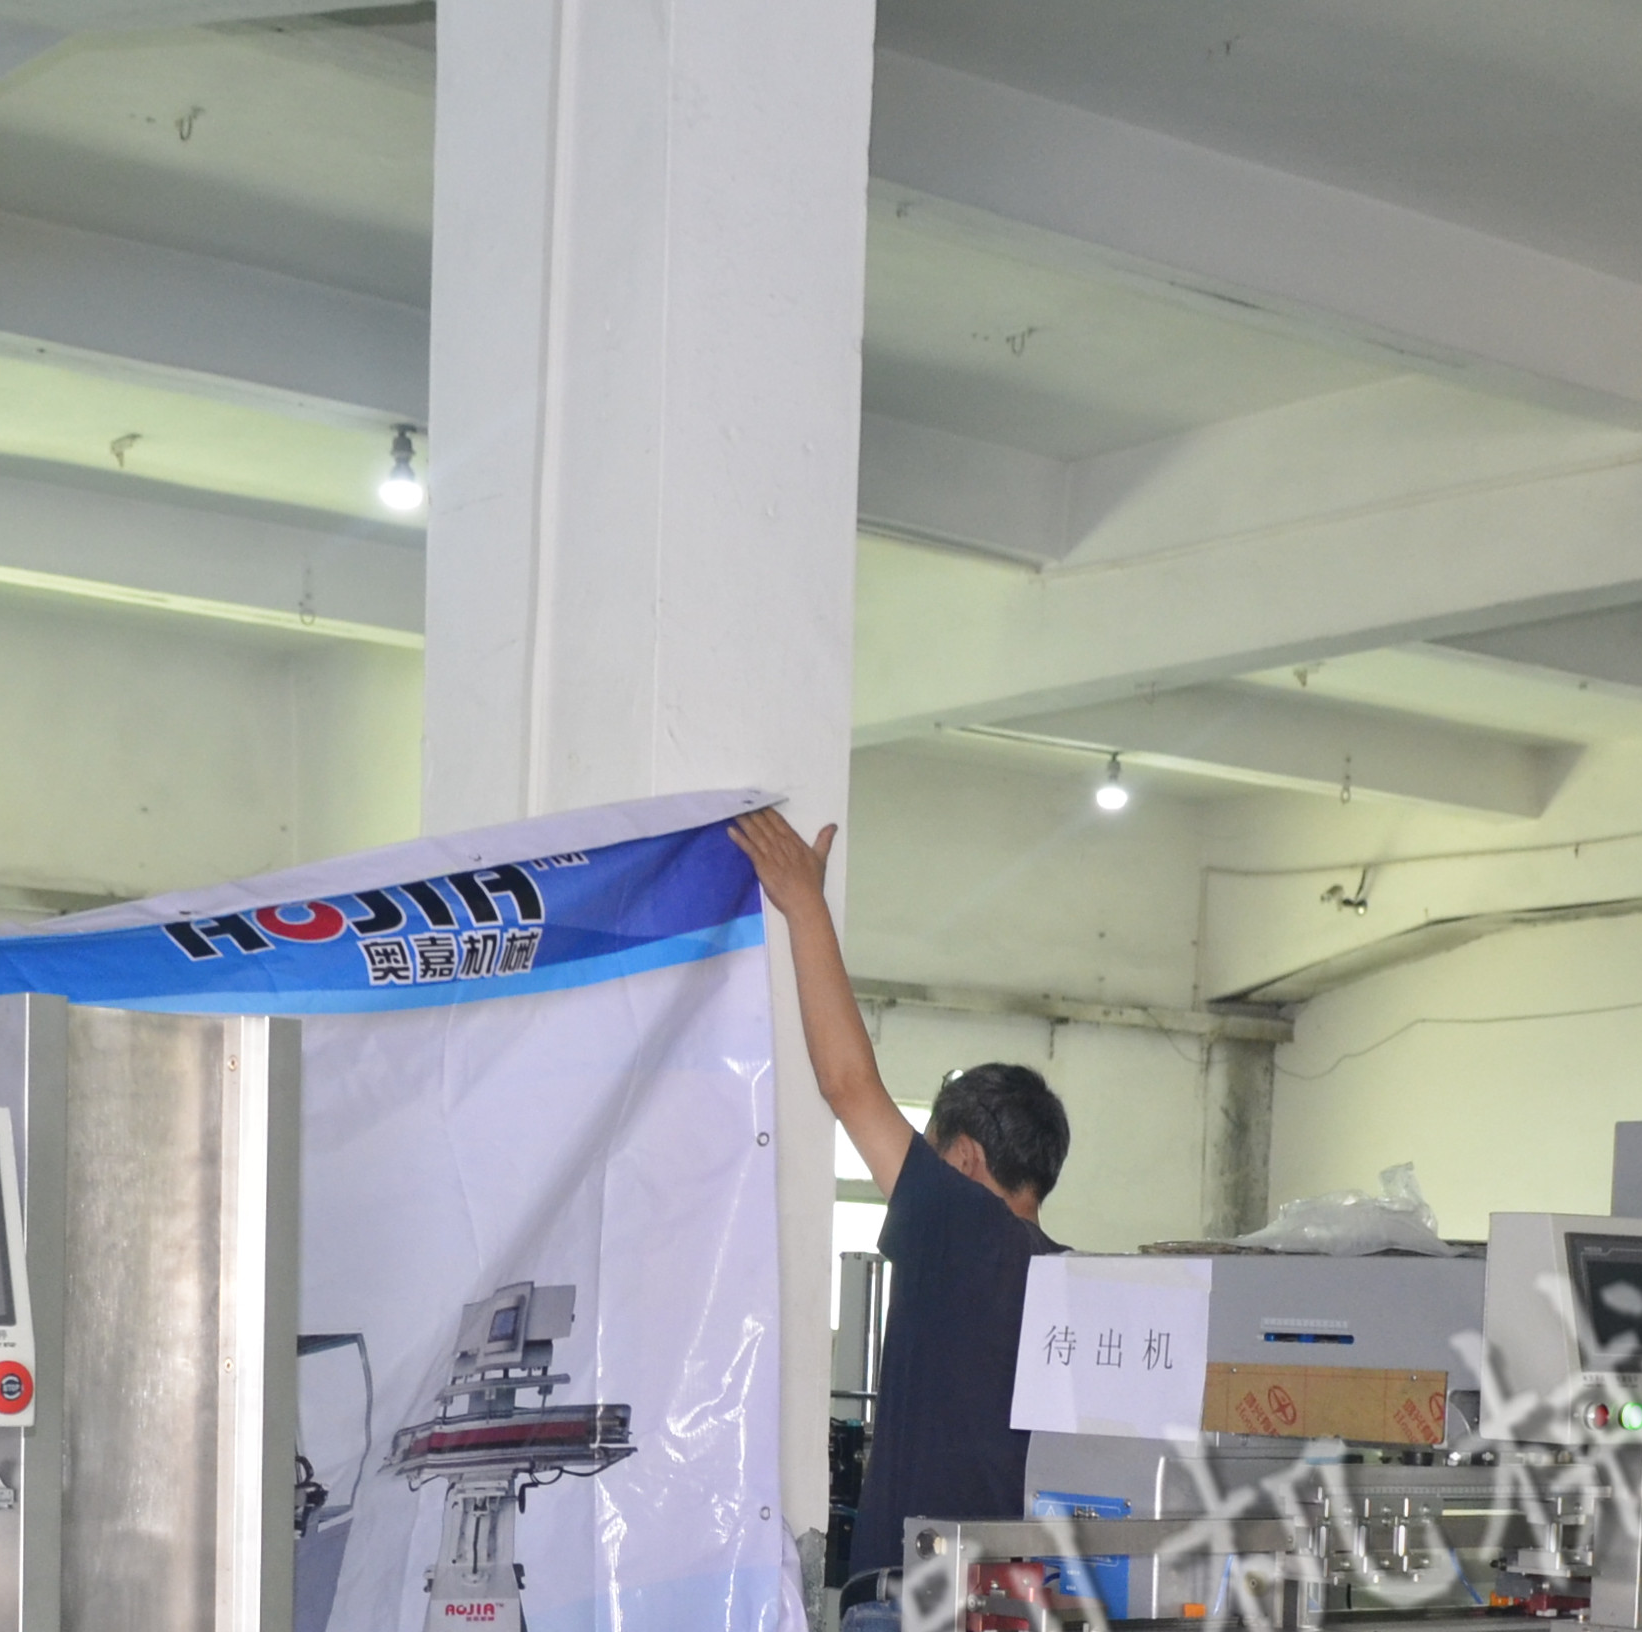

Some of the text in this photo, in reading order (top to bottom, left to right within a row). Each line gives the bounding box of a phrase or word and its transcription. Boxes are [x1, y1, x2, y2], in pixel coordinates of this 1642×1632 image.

[359, 927, 543, 986] 奥嘉机械
[1042, 1323, 1175, 1372] 待出机
